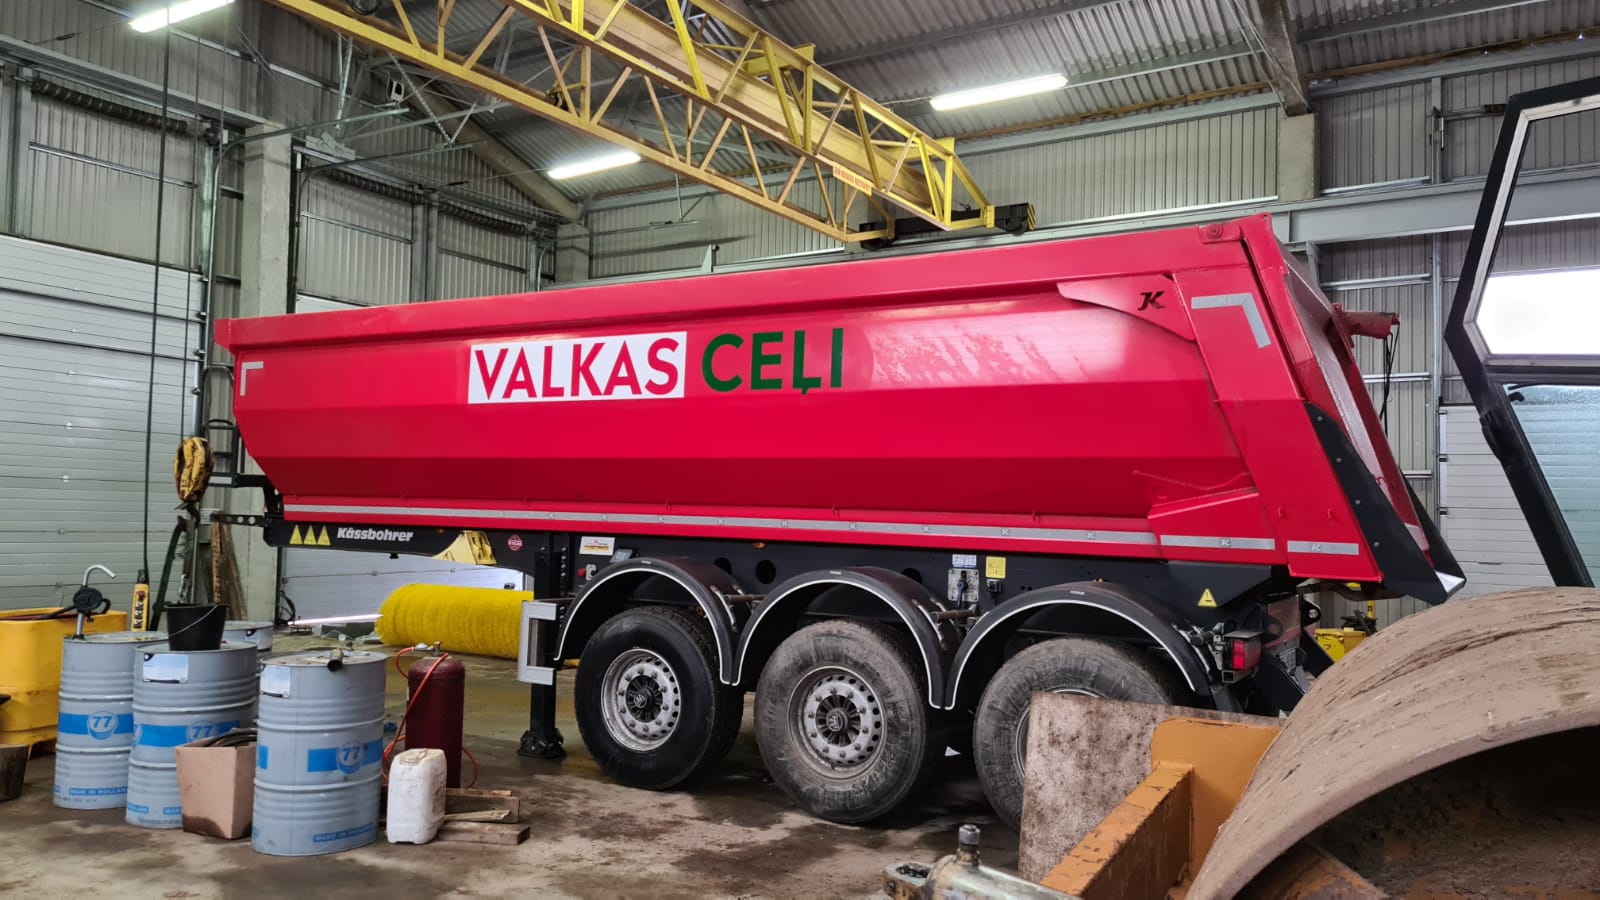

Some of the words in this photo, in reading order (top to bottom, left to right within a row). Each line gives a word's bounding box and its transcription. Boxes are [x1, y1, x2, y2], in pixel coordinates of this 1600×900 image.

[475, 337, 679, 400] VALKAS
[702, 328, 844, 395] CEĻI
[337, 527, 414, 541] Kässbohrer
[93, 716, 113, 729] 77
[192, 726, 212, 739] 77
[343, 745, 361, 762] 77
